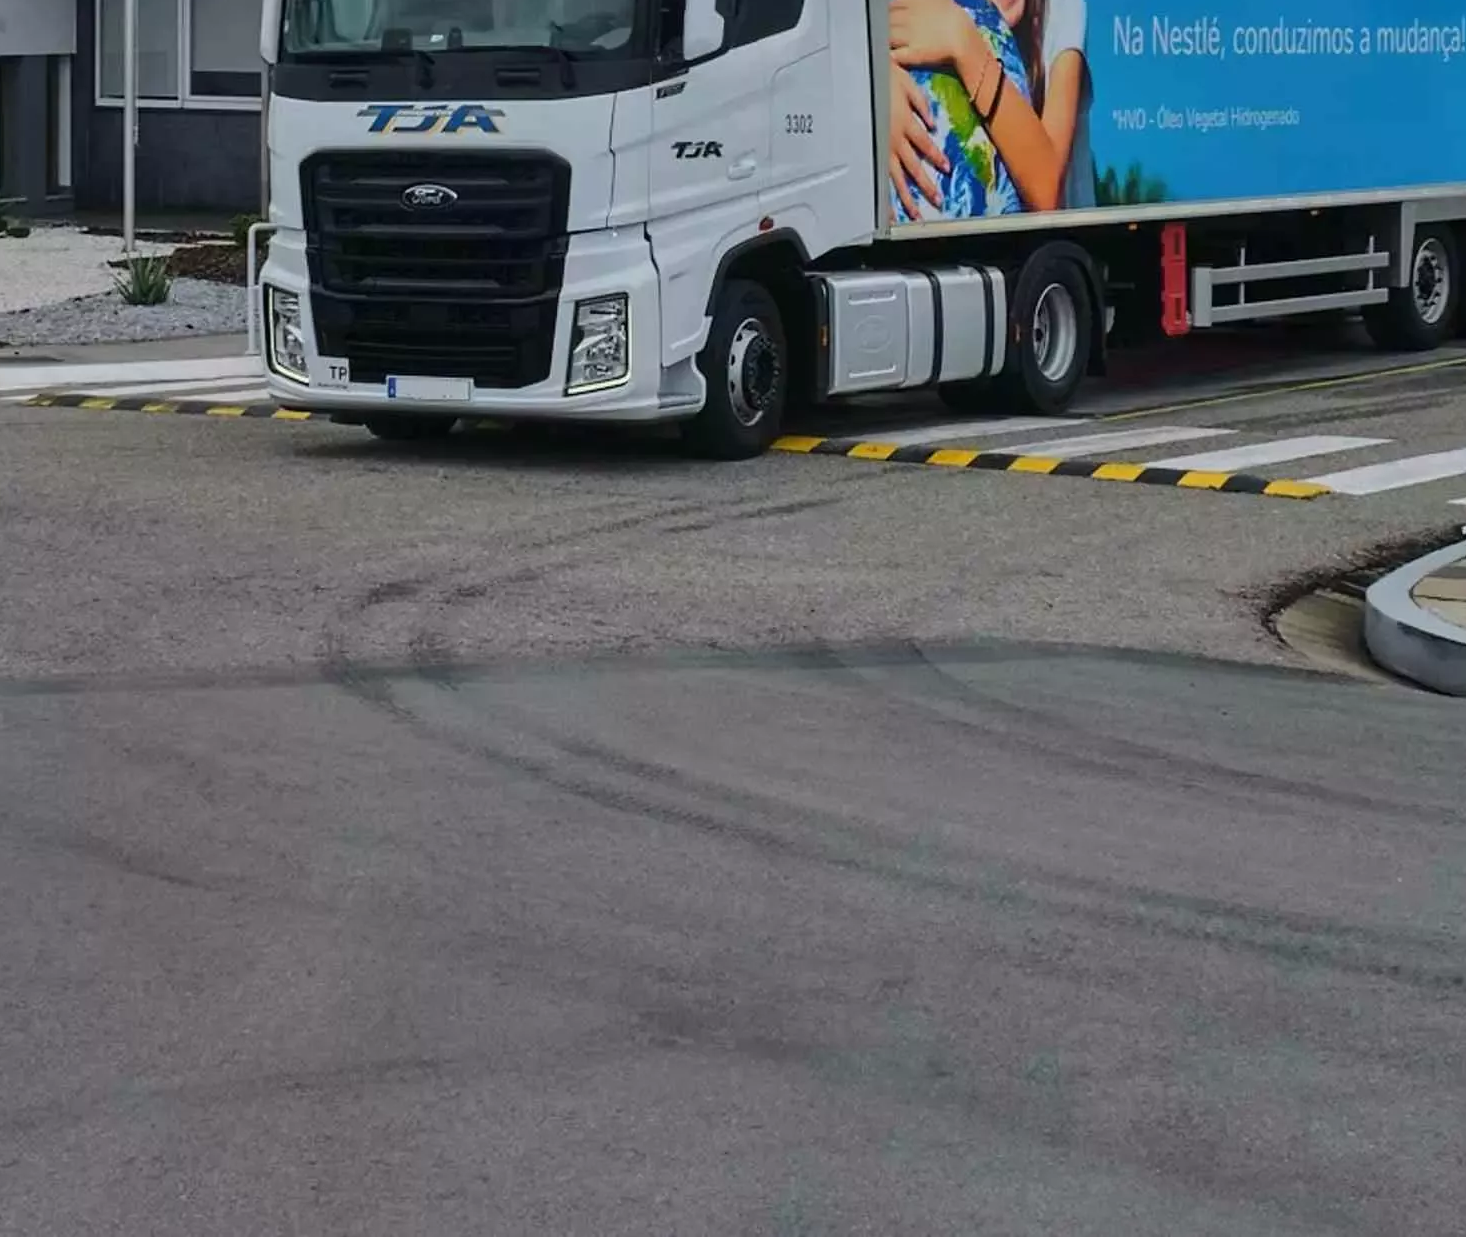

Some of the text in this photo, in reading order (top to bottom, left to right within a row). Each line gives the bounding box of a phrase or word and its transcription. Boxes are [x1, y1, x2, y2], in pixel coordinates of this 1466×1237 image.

[1113, 14, 1466, 63] Na Nestlé, conduzimos a mudança!
[356, 103, 507, 135] TJA
[785, 114, 814, 134] 3302
[671, 141, 723, 159] TJA
[328, 365, 348, 381] TP
